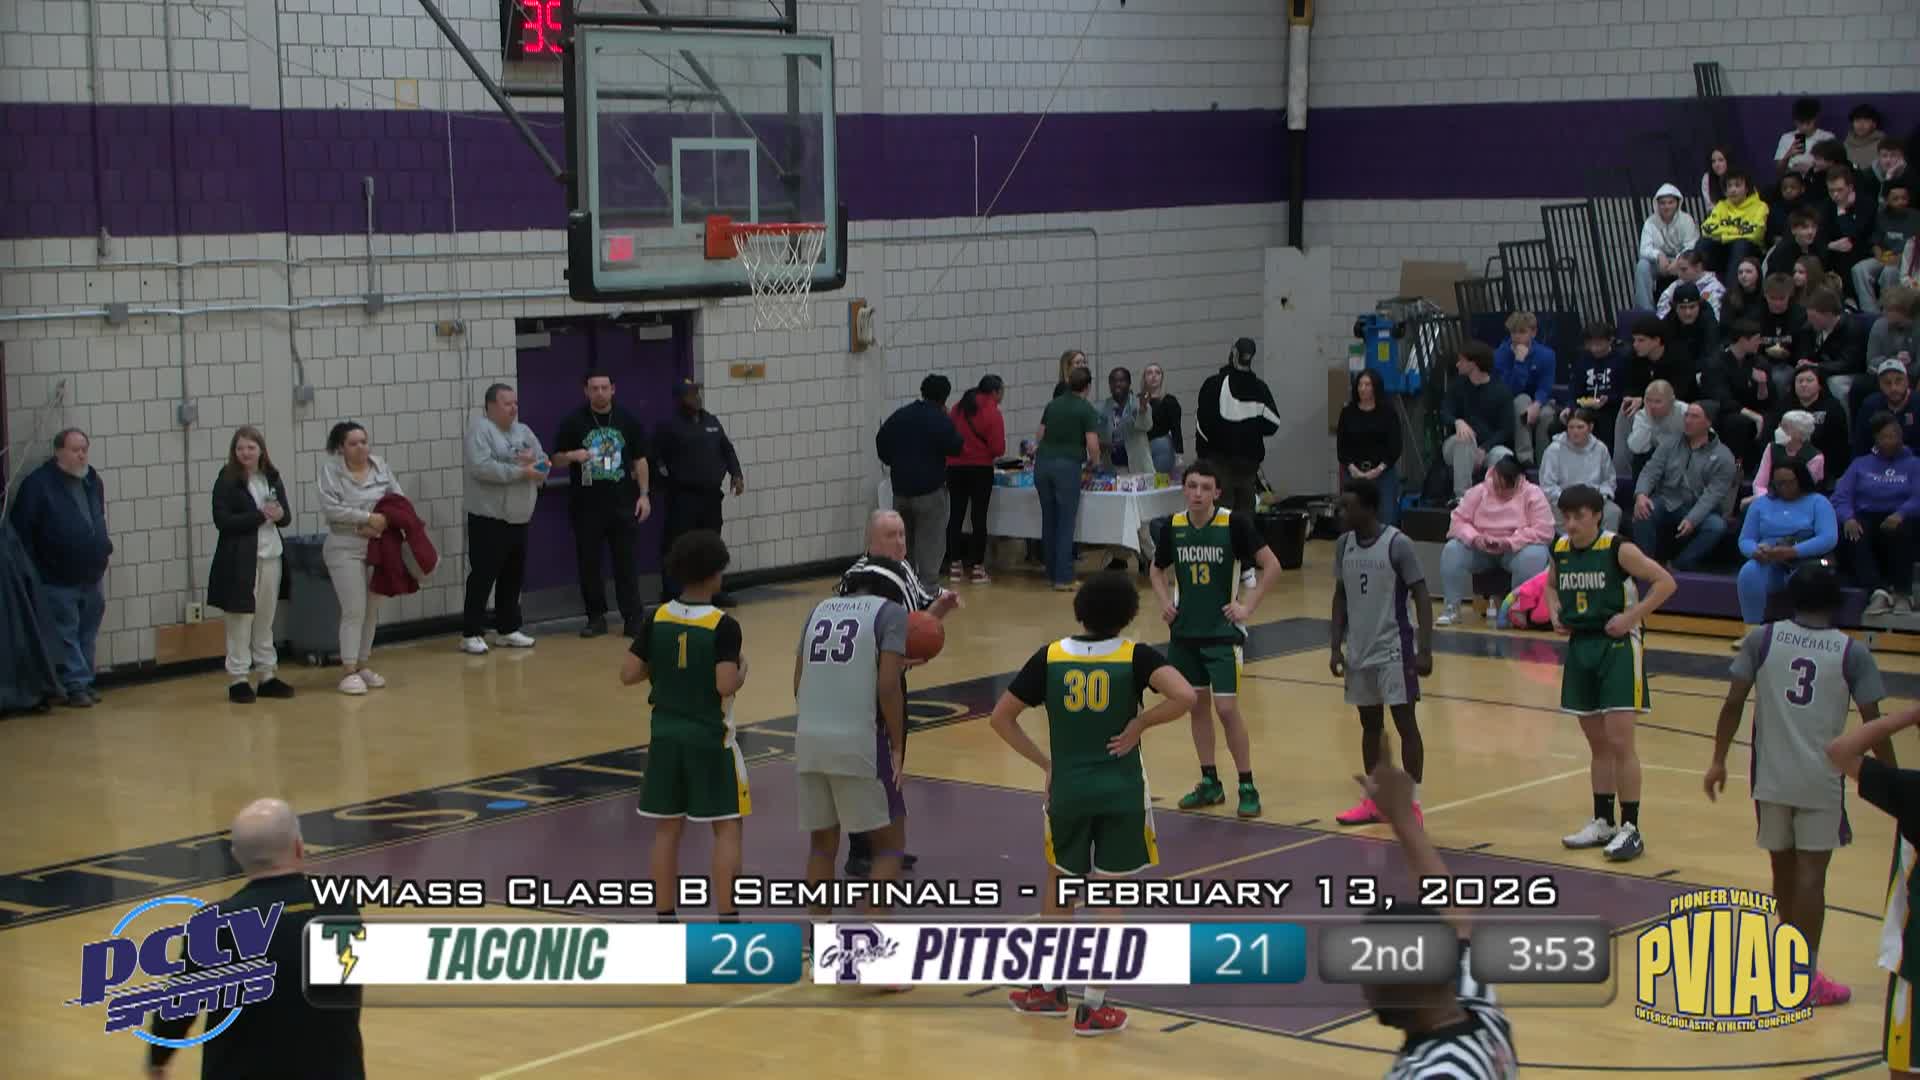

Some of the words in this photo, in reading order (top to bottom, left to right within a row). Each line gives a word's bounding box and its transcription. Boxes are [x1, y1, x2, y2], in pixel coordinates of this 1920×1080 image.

[1176, 545, 1224, 565] TACONIC
[1190, 563, 1210, 585] 13
[1359, 573, 1368, 595] 2
[1559, 571, 1606, 591] TACONIC
[677, 631, 688, 668] 1
[808, 618, 859, 664] 23
[1776, 631, 1841, 653] GENERALS
[1063, 669, 1110, 713] 30
[1785, 657, 1817, 707] 3
